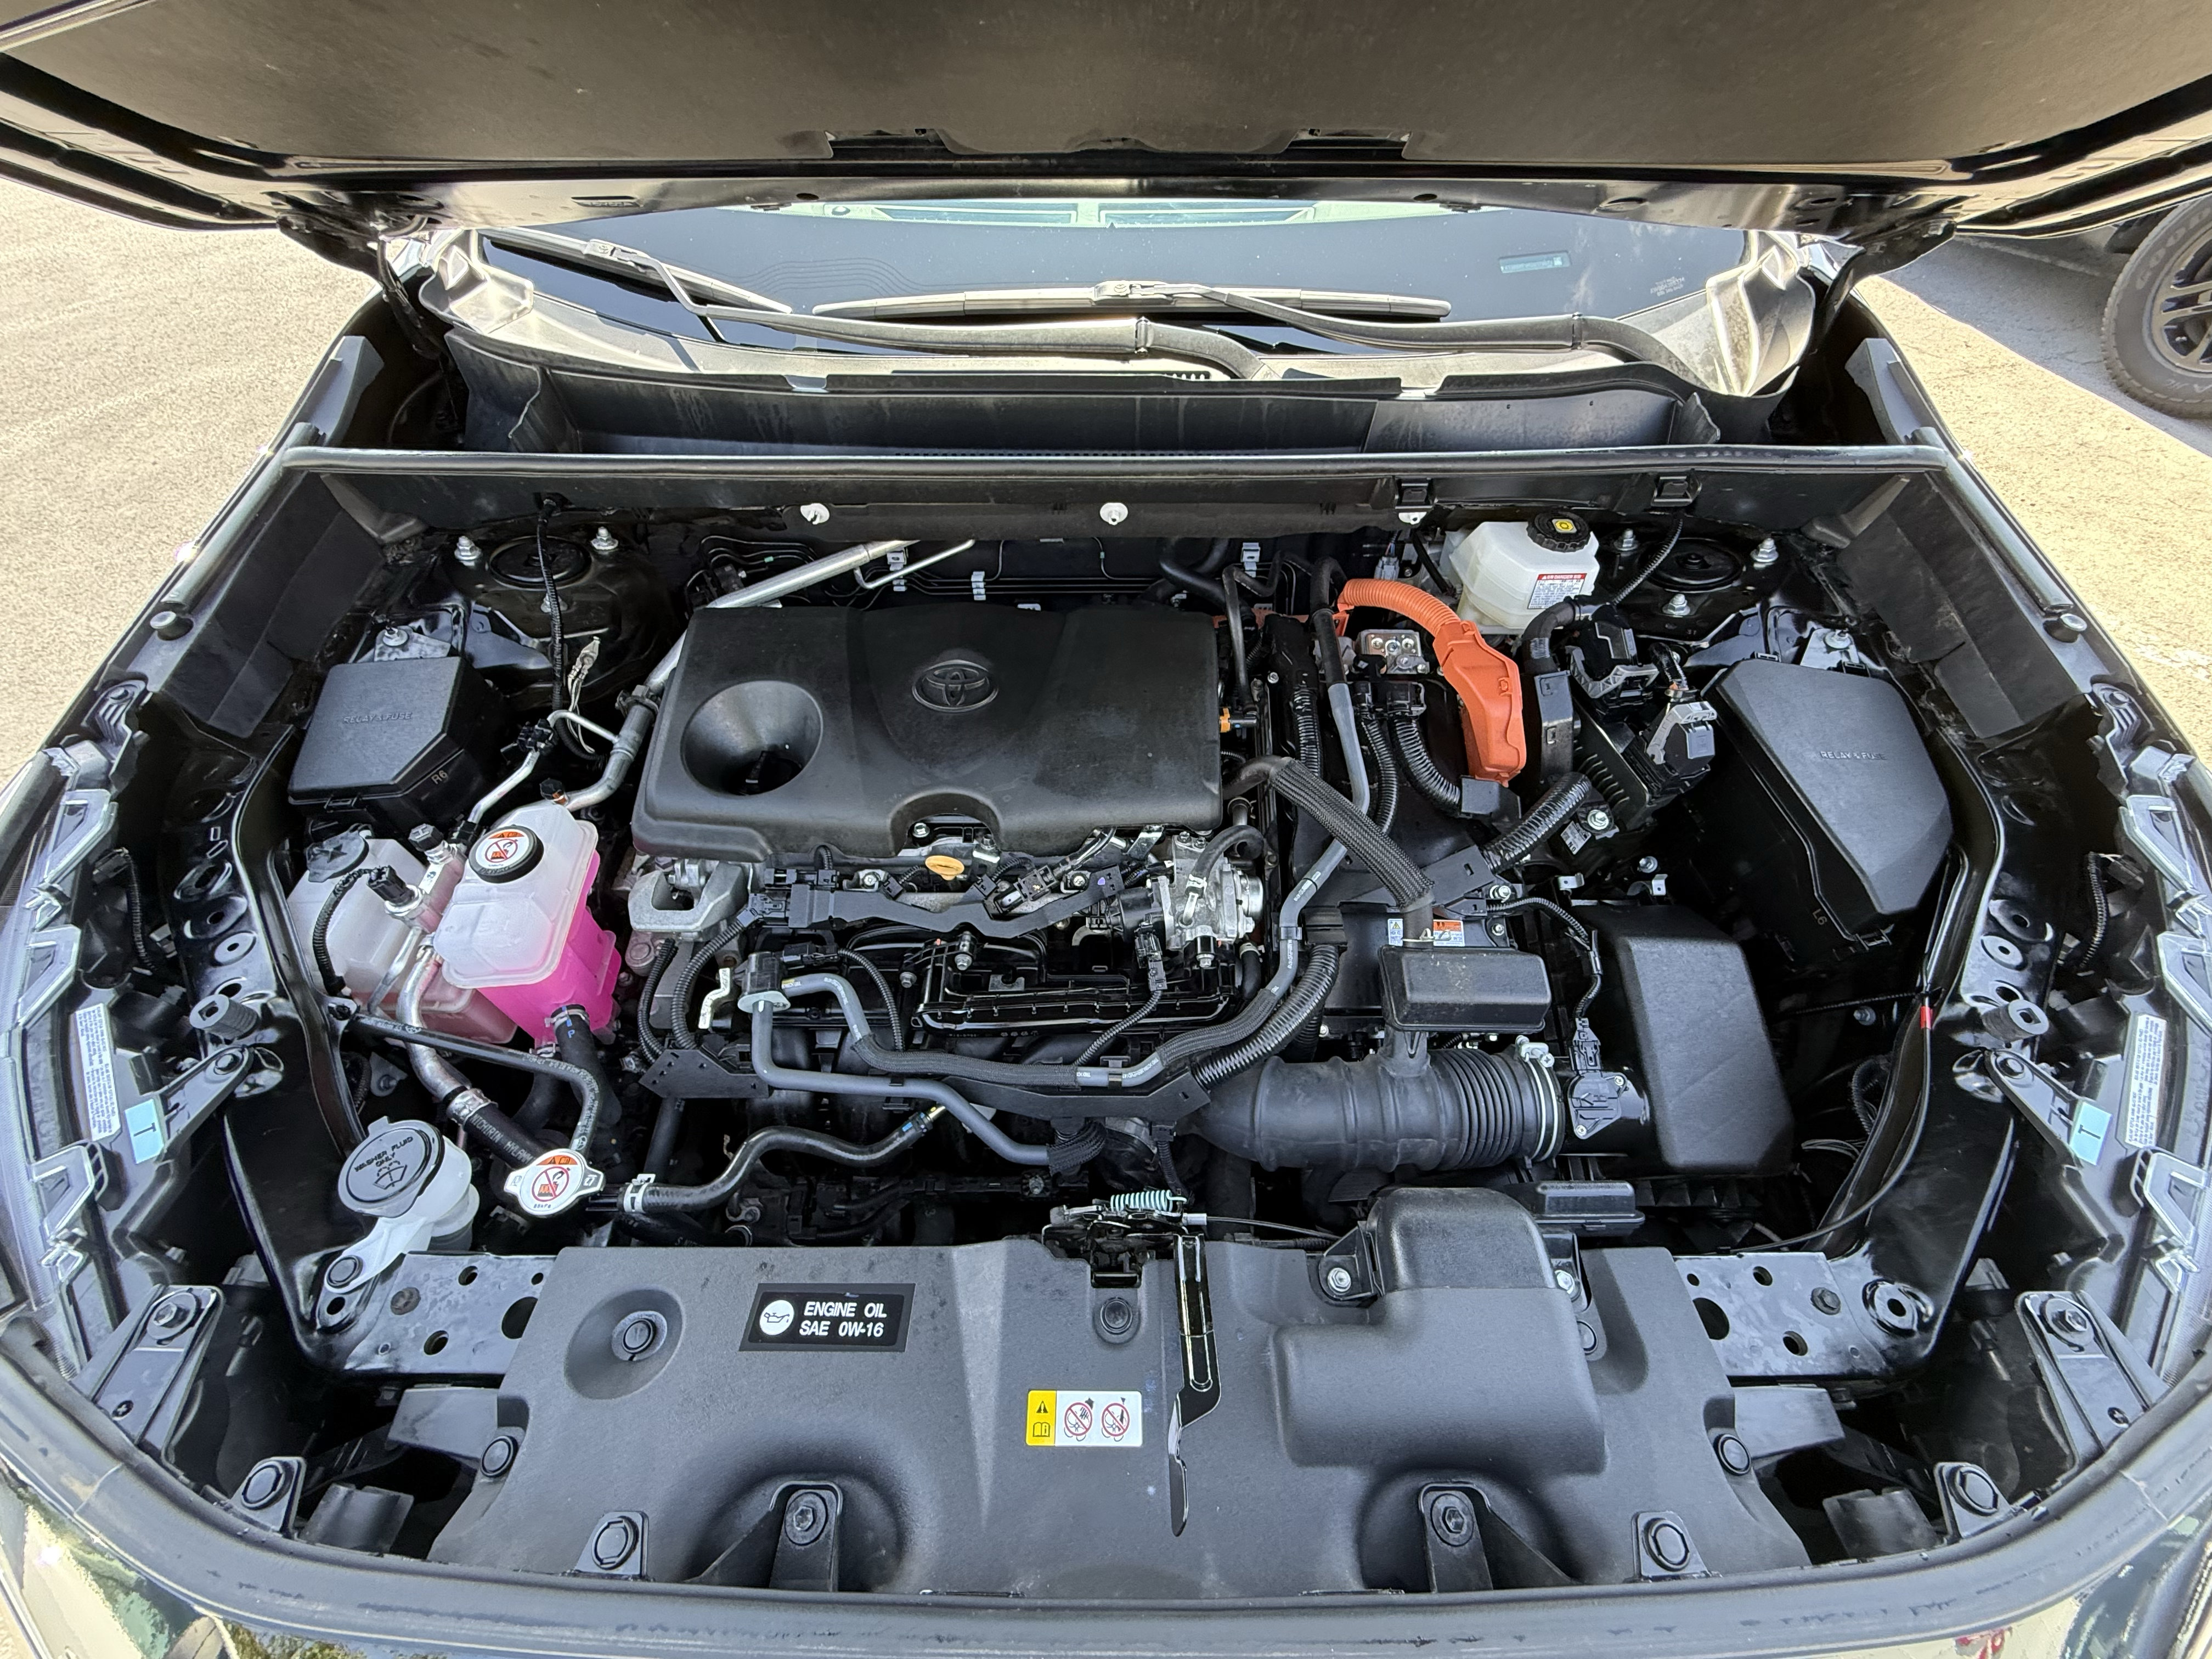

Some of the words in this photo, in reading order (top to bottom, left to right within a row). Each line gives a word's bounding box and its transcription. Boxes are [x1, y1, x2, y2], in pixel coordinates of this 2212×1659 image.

[342, 713, 377, 724] RELAY
[386, 711, 413, 721] FUSE
[1819, 751, 1851, 759] RELAY
[1861, 752, 1887, 760] FUSE
[431, 770, 448, 785] R6
[1812, 908, 1828, 926] L6
[133, 1121, 157, 1138] T
[470, 1113, 504, 1144] NICHIRIN
[2078, 1124, 2101, 1140] T
[391, 1136, 414, 1152] FLUID
[375, 1152, 396, 1168] ONLY
[803, 1301, 857, 1318] ENGINE
[864, 1302, 888, 1318] OIL
[799, 1320, 831, 1336] SAE
[838, 1321, 885, 1338] 0W-16
